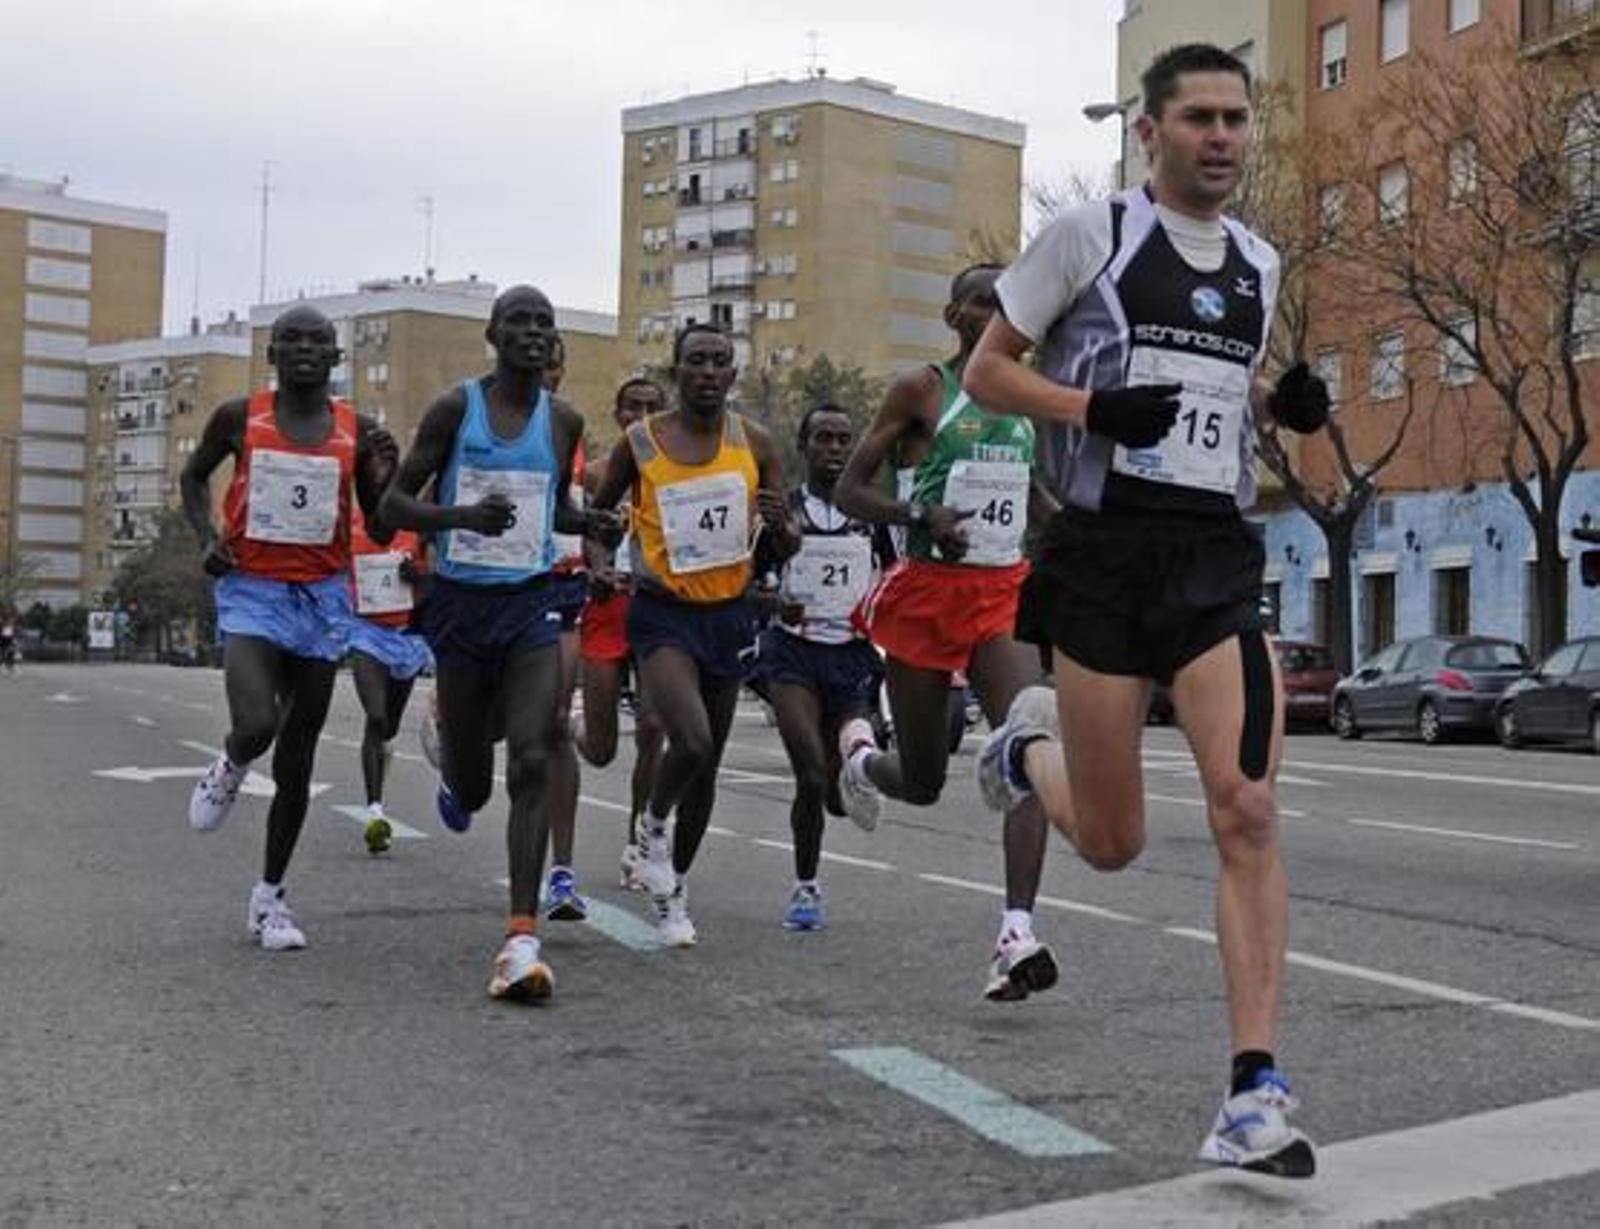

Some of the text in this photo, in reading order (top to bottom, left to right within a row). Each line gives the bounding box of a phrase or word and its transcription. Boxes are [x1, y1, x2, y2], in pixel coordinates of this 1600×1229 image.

[1181, 407, 1222, 450] 15
[291, 485, 308, 510] 3
[698, 505, 729, 532] 47
[980, 499, 1013, 527] 46
[822, 564, 849, 587] 21
